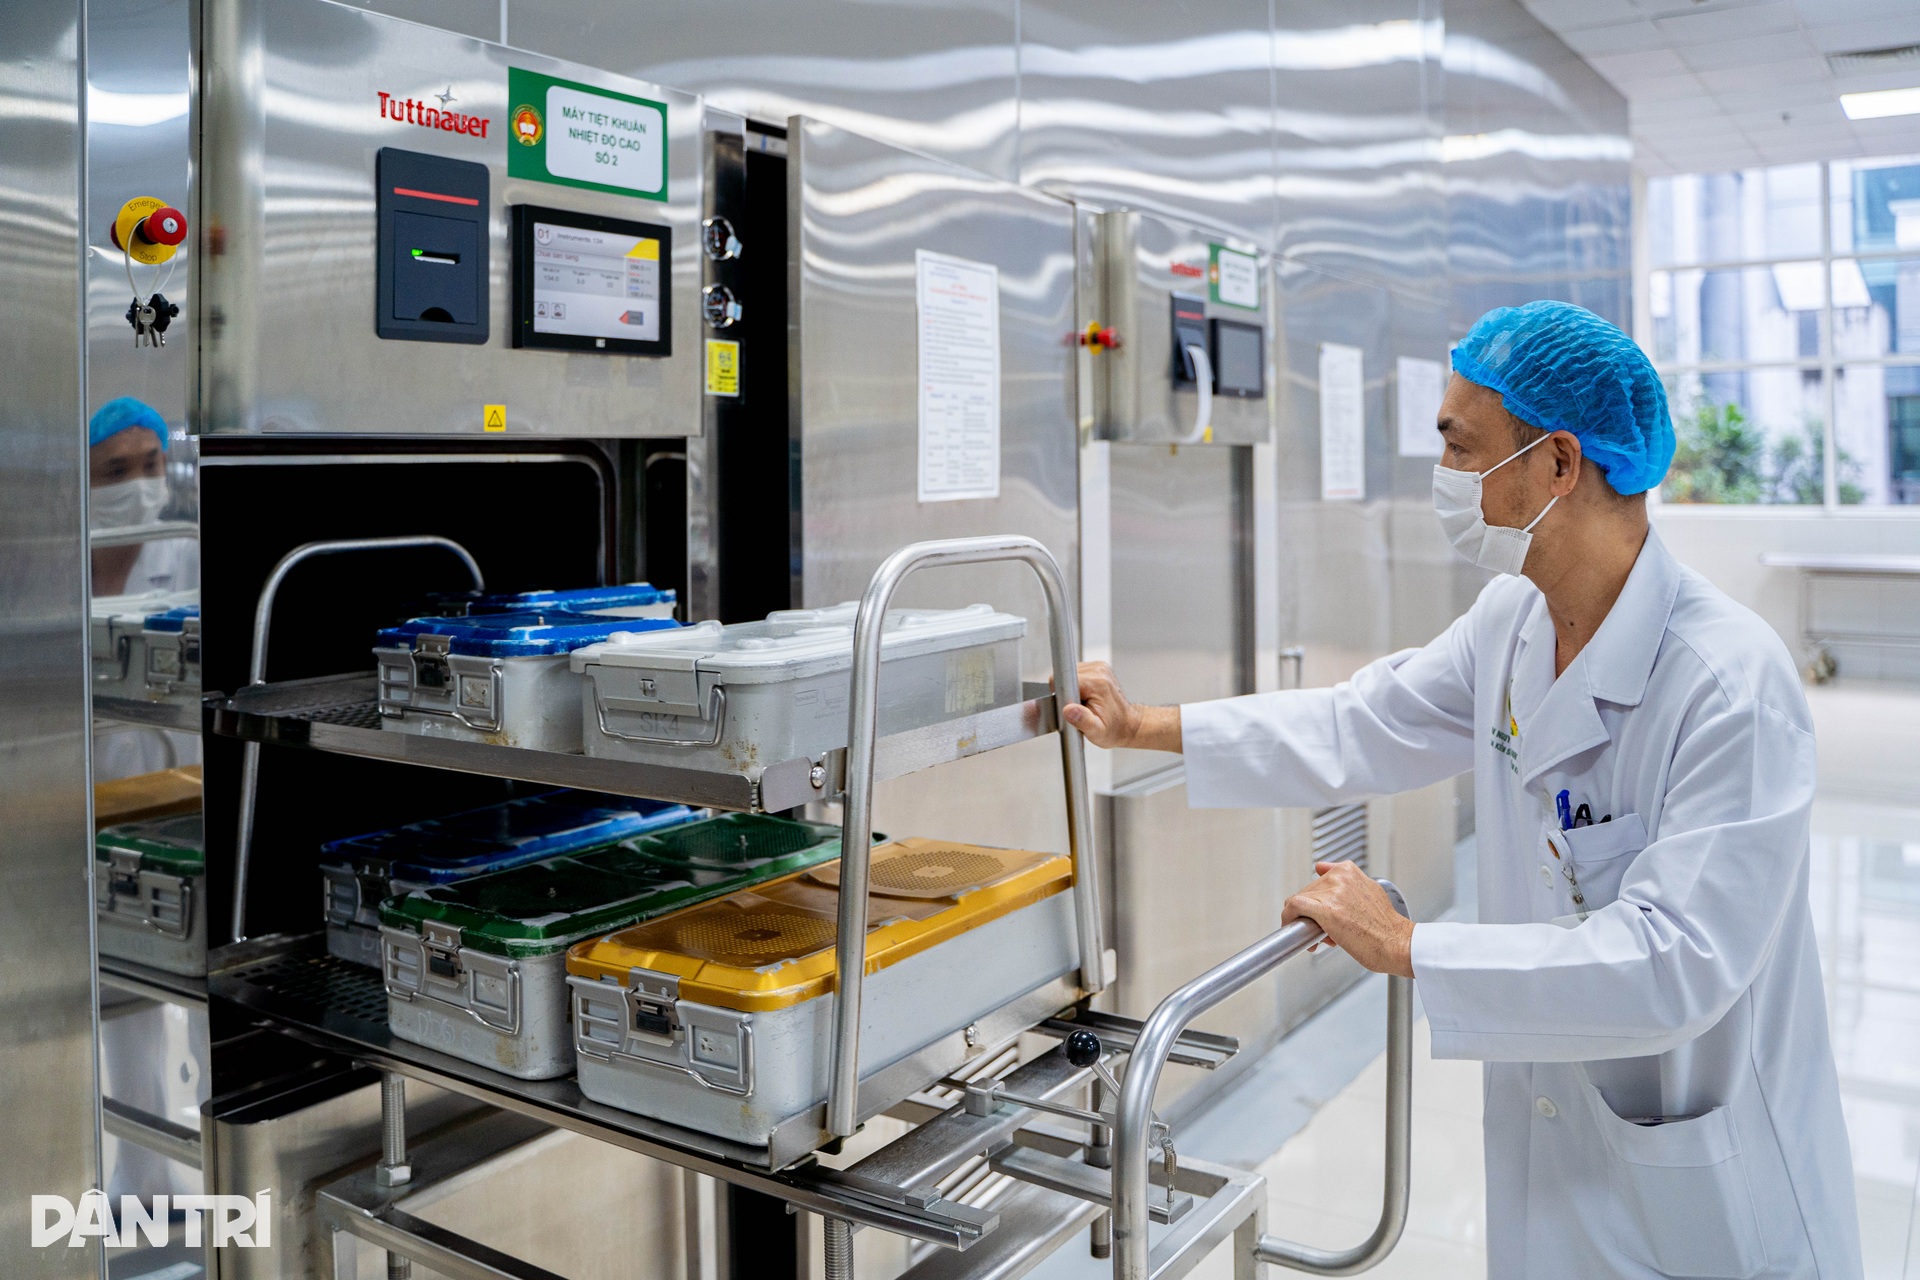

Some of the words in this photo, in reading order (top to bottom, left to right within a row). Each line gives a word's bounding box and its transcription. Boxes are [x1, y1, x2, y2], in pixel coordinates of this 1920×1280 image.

[378, 91, 490, 138] Tuttnauer
[562, 106, 585, 121] MÁY
[619, 137, 641, 152] CAO
[612, 155, 619, 166] 2
[128, 200, 164, 212] Emerge
[538, 229, 550, 241] 01
[139, 251, 158, 262] Stop
